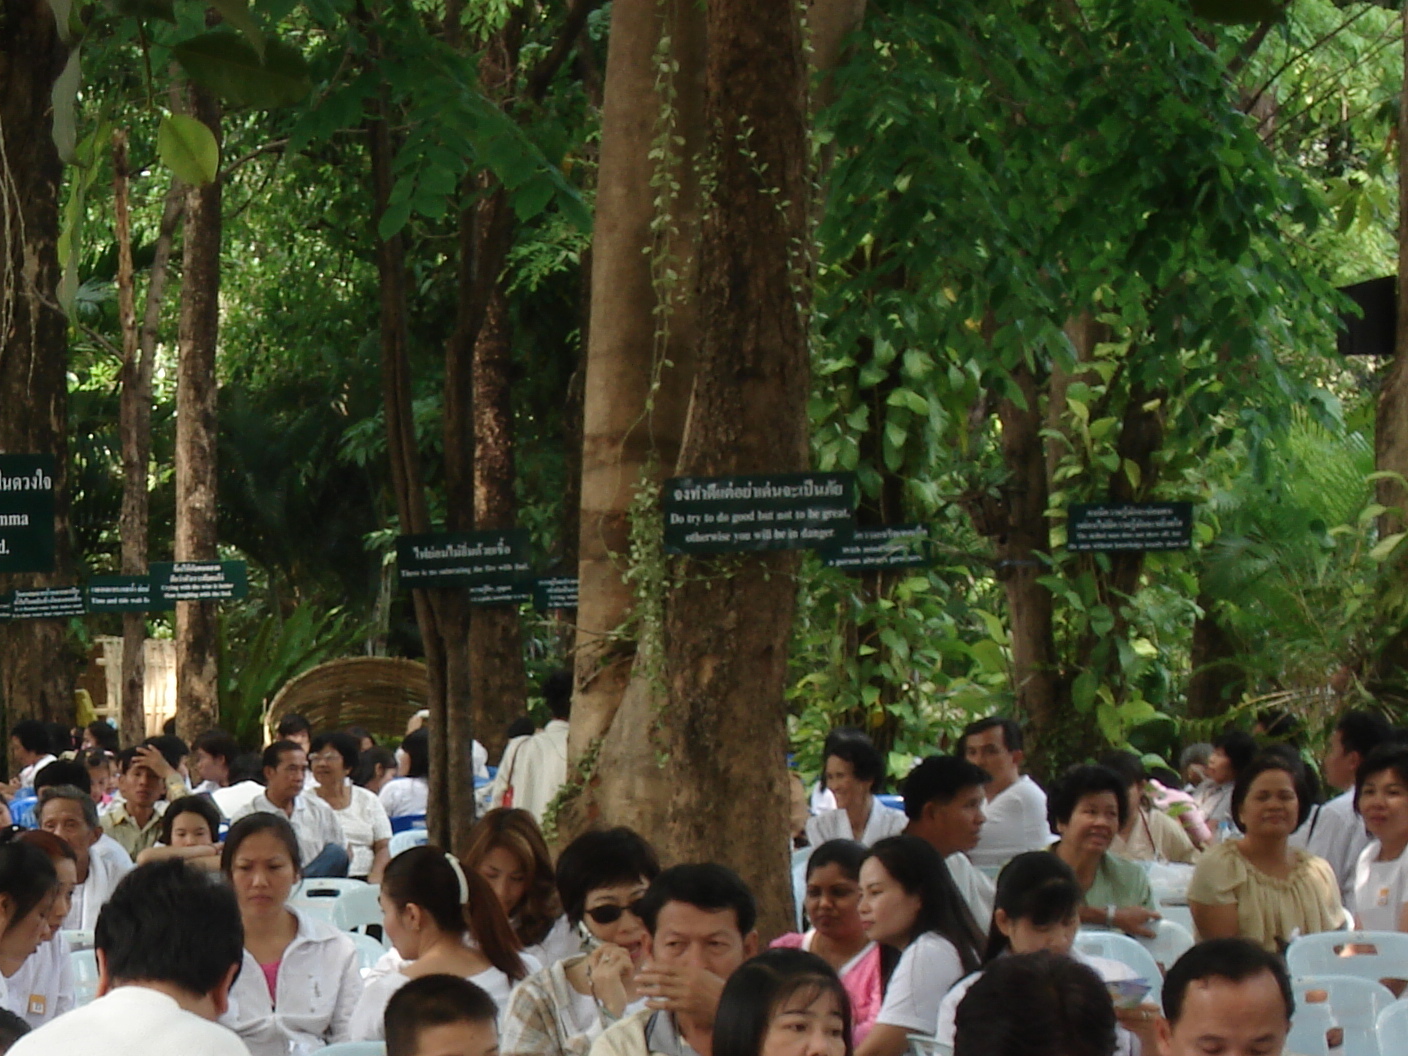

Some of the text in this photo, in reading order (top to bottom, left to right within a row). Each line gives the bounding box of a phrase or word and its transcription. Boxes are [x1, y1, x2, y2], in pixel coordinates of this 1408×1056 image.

[670, 512, 685, 526] Do
[687, 513, 702, 527] try
[704, 513, 714, 523] to
[716, 511, 730, 523] do
[732, 510, 755, 525] good
[757, 509, 774, 521] but
[776, 509, 793, 521] not
[795, 510, 805, 520] to
[807, 507, 820, 519] be
[685, 530, 731, 542] otherwise
[733, 531, 751, 545] you
[753, 528, 772, 540] will
[774, 528, 786, 539] be
